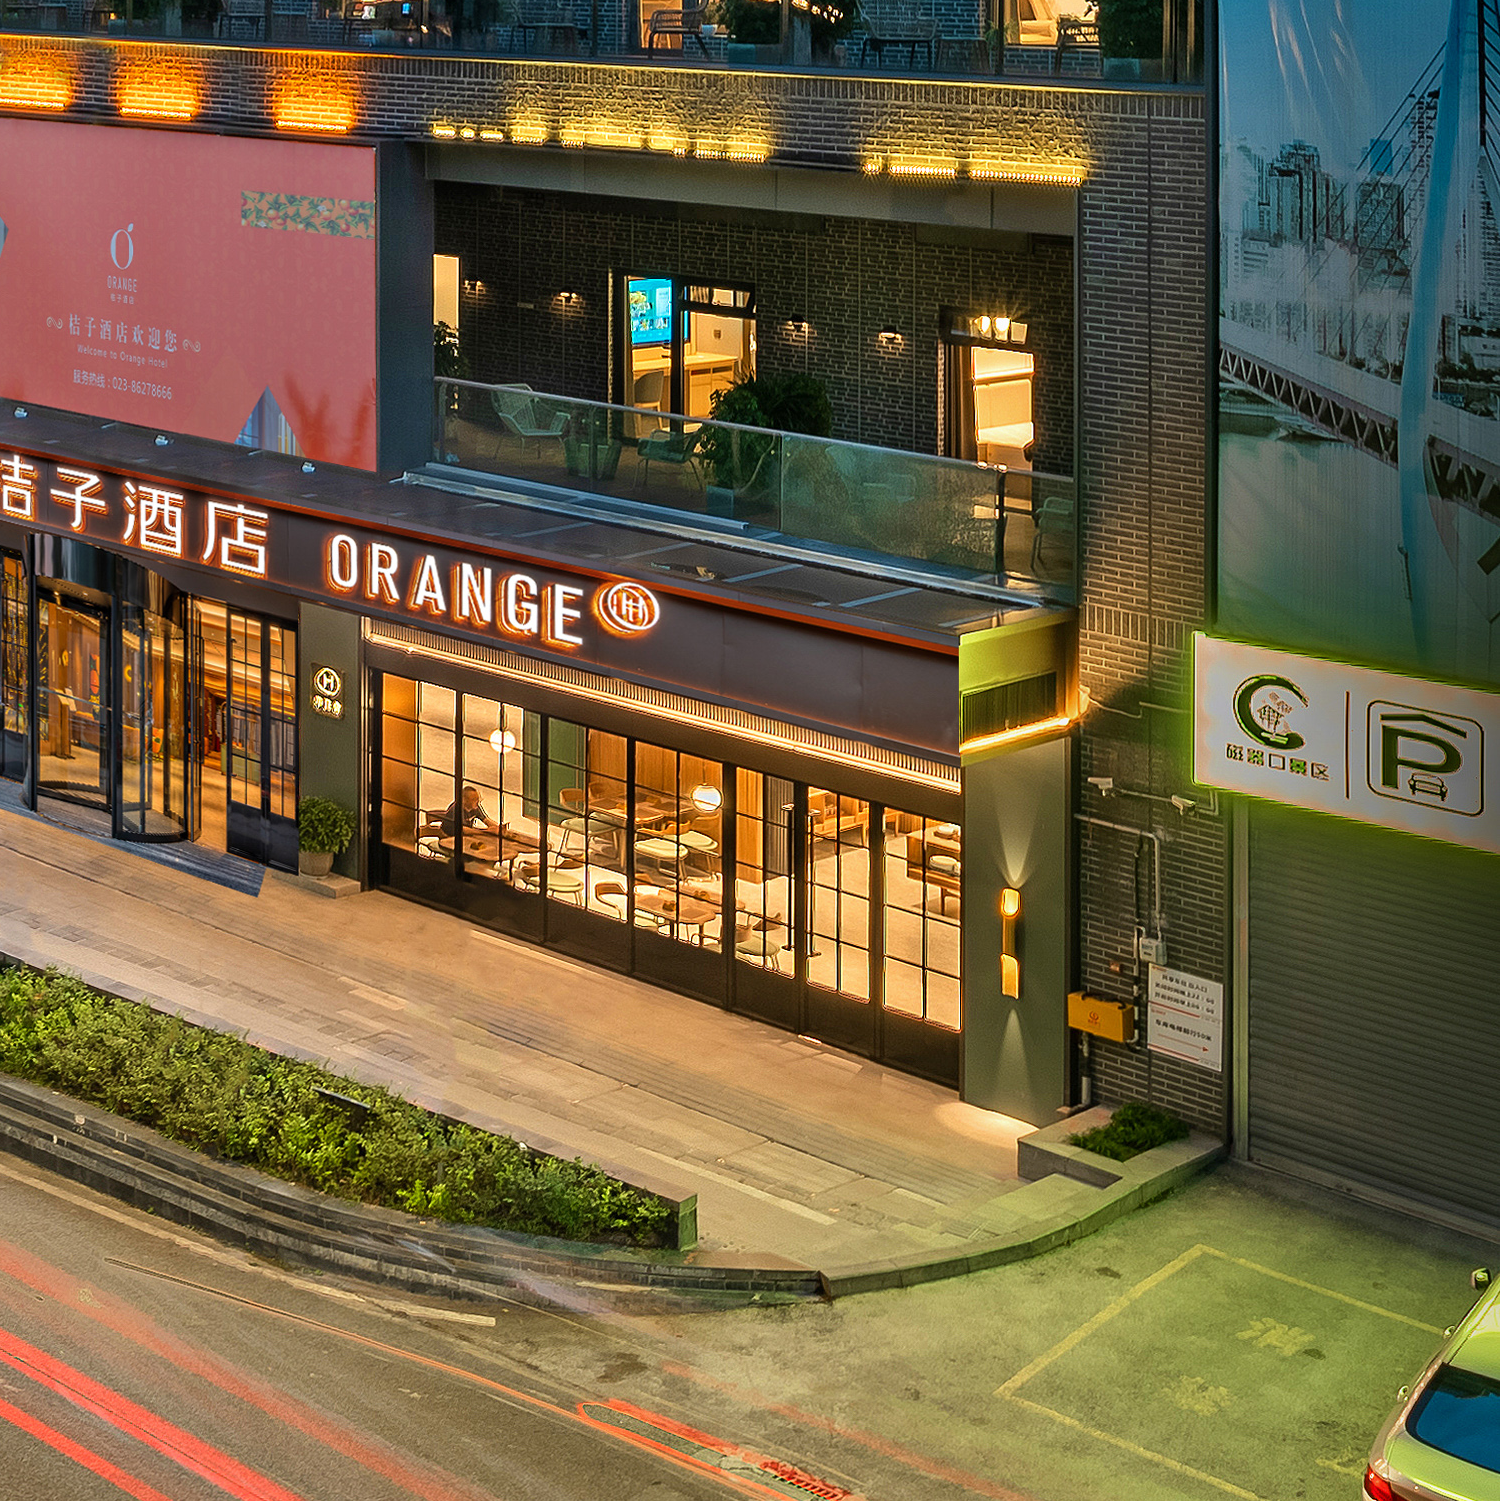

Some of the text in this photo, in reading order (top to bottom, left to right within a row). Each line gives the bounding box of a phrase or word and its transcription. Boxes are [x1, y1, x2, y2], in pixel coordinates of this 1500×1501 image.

[107, 275, 138, 293] ORANGE
[68, 313, 178, 353] 桔子酒店欢迎您
[77, 343, 169, 369] Welcome to Orange Hotel
[329, 533, 584, 647] ORANGE
[1381, 724, 1463, 790] P
